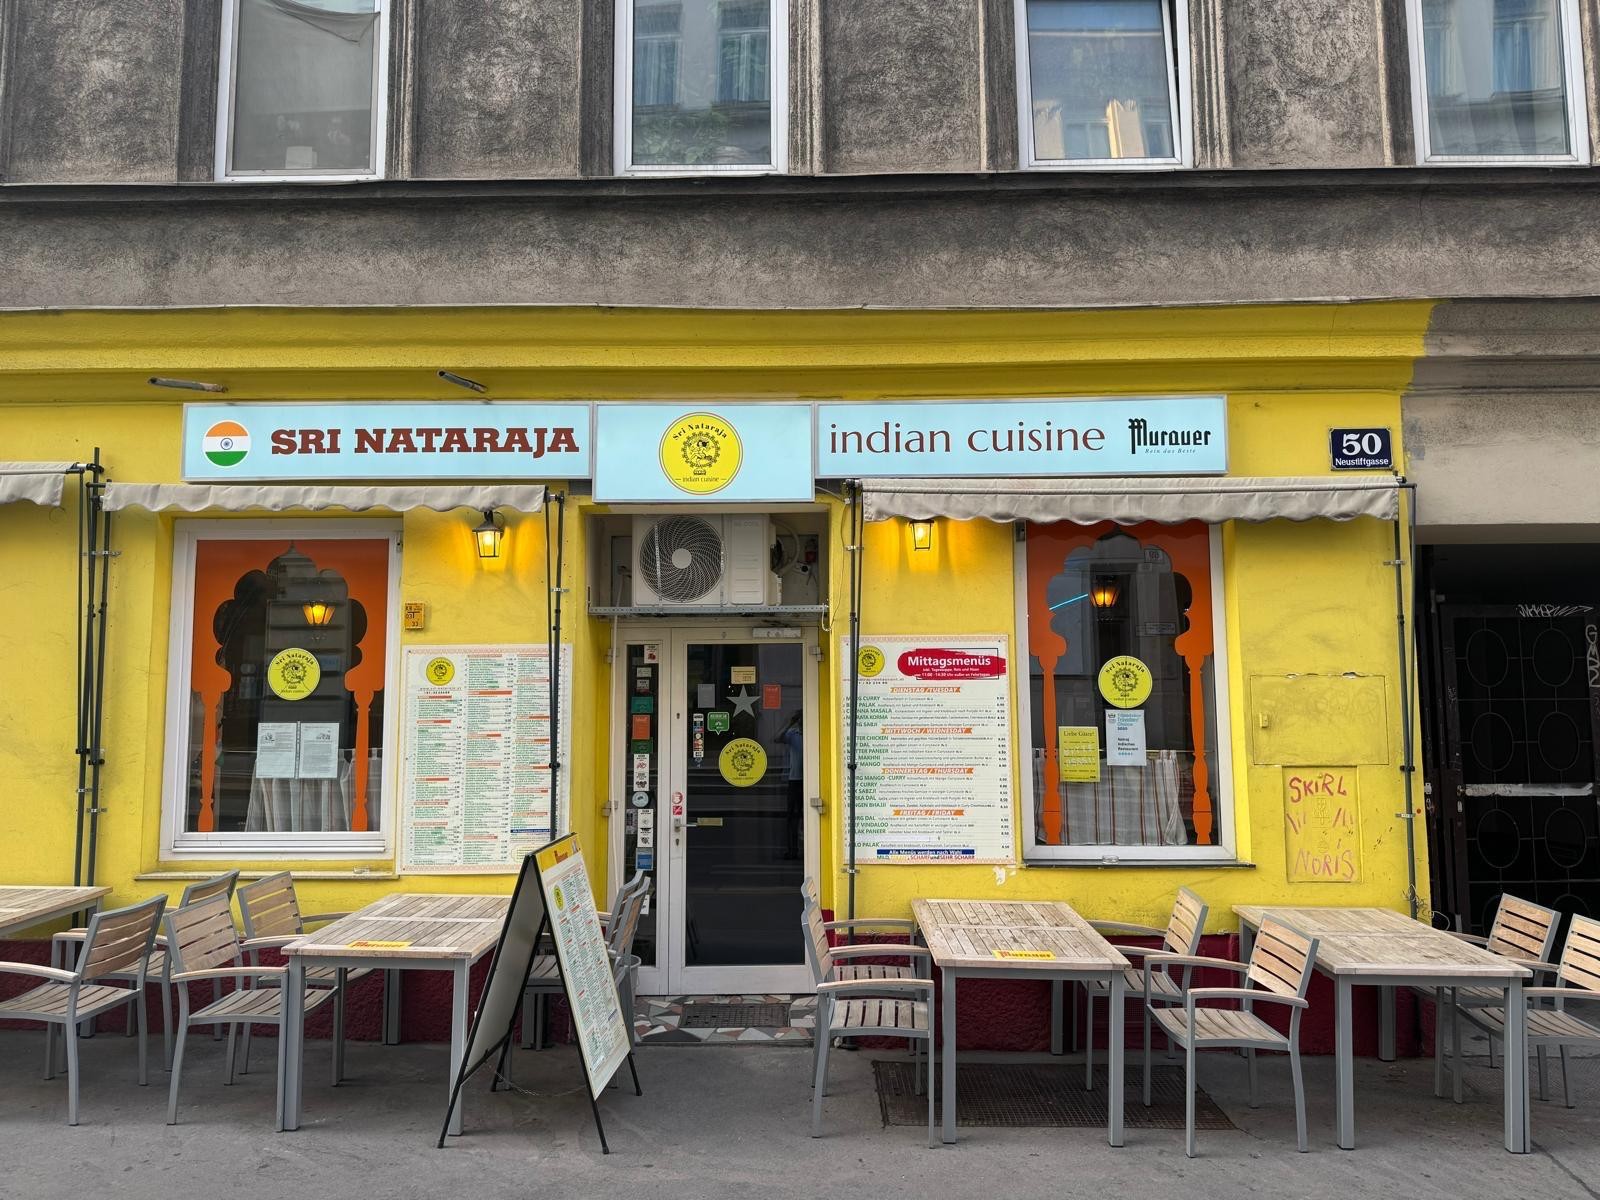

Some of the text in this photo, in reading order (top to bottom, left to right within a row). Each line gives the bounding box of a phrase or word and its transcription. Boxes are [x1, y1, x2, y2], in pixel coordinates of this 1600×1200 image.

[271, 427, 580, 459] SRI NATARAJA
[672, 423, 728, 440] Sri Nataraja
[830, 421, 1105, 454] indian cuisine
[1128, 418, 1211, 454] Murauer
[1342, 433, 1382, 456] 50
[1335, 458, 1389, 467] Neustiftgasse
[908, 655, 991, 668] Mittagsmenüs
